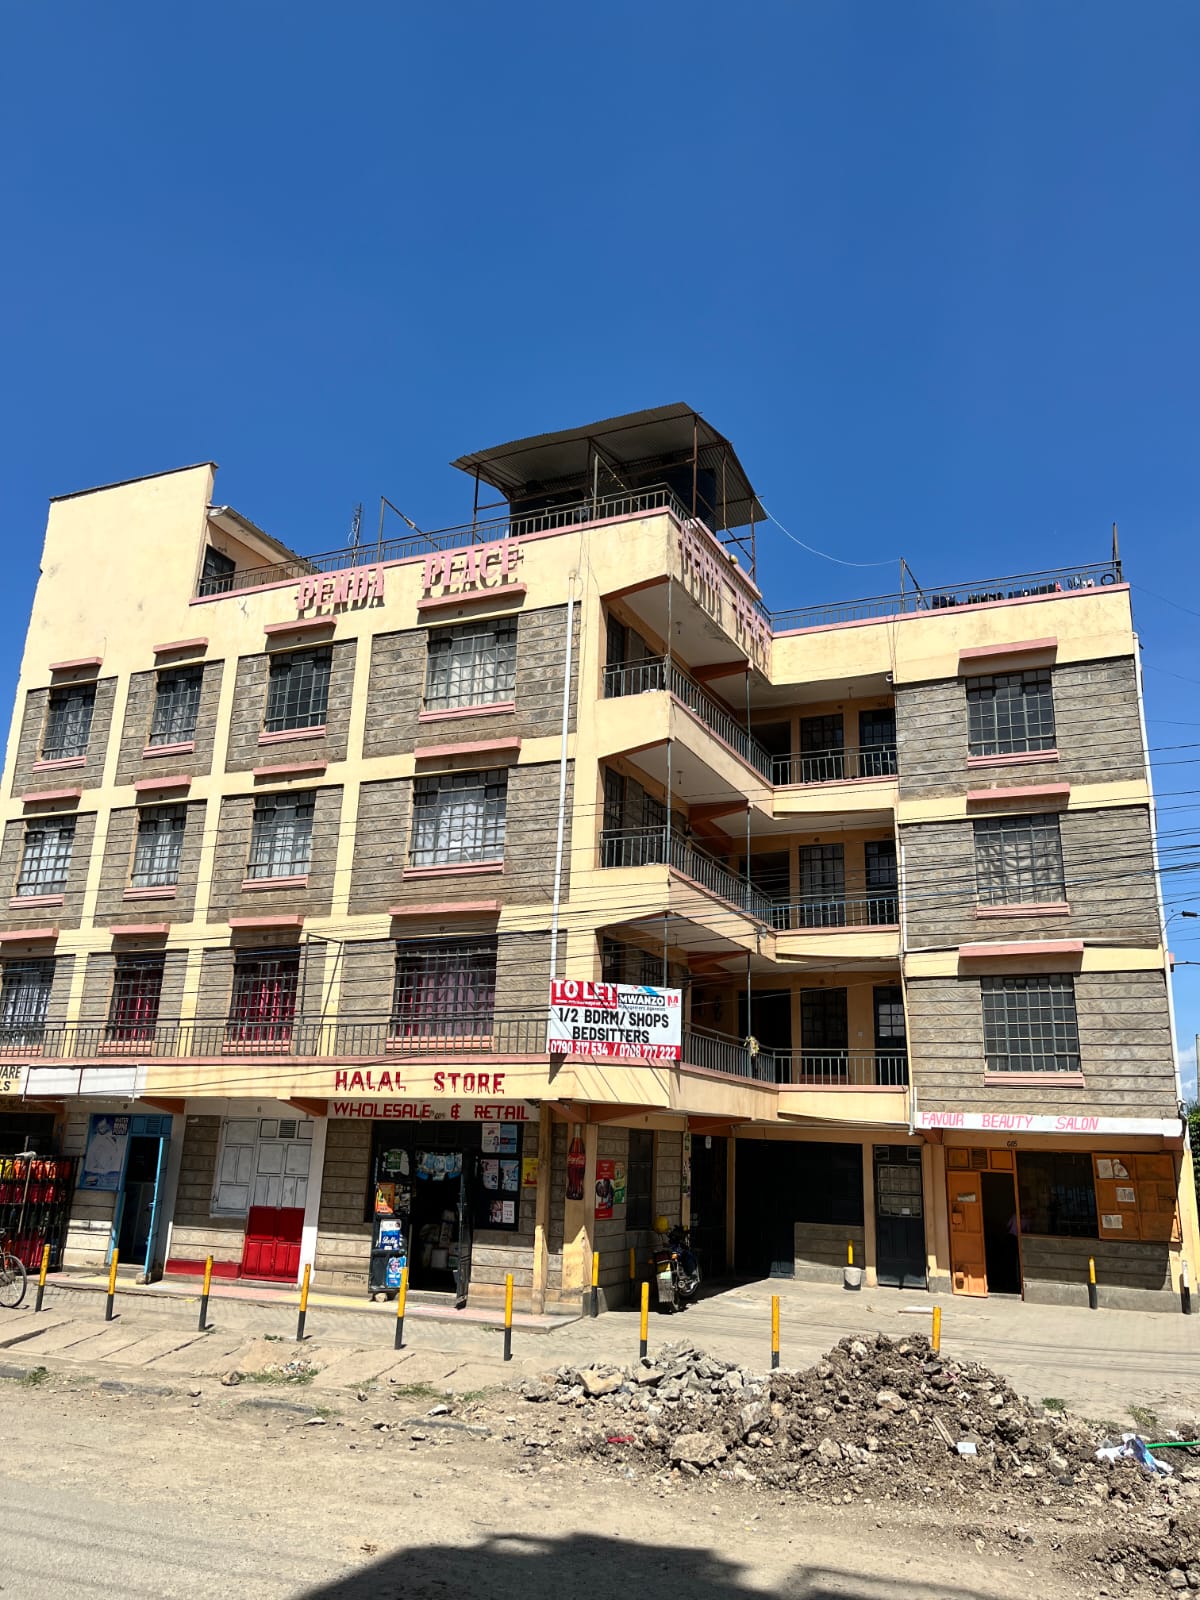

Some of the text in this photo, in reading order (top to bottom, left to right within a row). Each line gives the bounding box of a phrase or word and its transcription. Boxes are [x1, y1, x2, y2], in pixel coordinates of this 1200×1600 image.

[296, 542, 520, 611] PENDA PLACE
[679, 520, 772, 653] PENDA PLACE
[552, 979, 617, 1001] TO LET
[618, 993, 665, 1006] MWANZO
[558, 1007, 669, 1028] 1/2 BDRM/ SHOPS
[572, 1026, 650, 1044] BEDSITTERS
[550, 1040, 574, 1054] 0790
[575, 1042, 590, 1055] 317
[591, 1043, 608, 1057] 534
[612, 1044, 618, 1057] /
[659, 1046, 677, 1061] 222
[0, 1080, 11, 1092] S
[335, 1070, 506, 1094] HALAL STORE
[333, 1102, 431, 1119] WHOLESALE
[474, 1104, 529, 1120] RETAIL
[921, 1112, 1099, 1131] FAVOUR BEAUTY SALON
